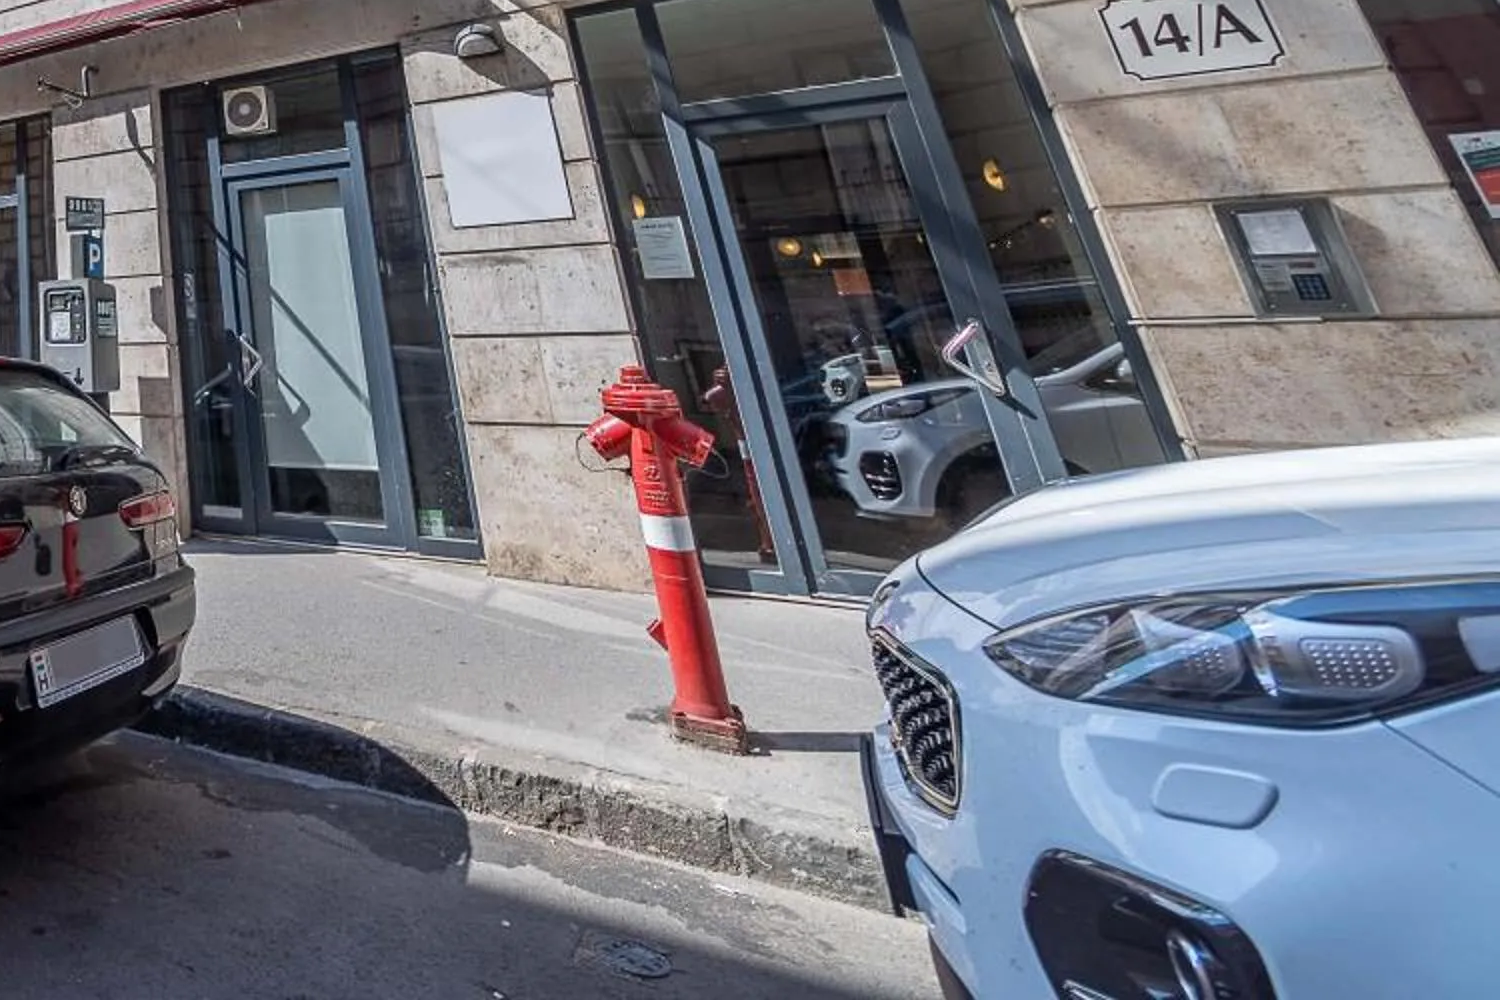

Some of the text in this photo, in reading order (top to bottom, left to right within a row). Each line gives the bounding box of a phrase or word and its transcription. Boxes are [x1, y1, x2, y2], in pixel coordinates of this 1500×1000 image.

[1119, 3, 1263, 57] 14/A
[89, 243, 101, 271] P
[38, 672, 49, 692] H
